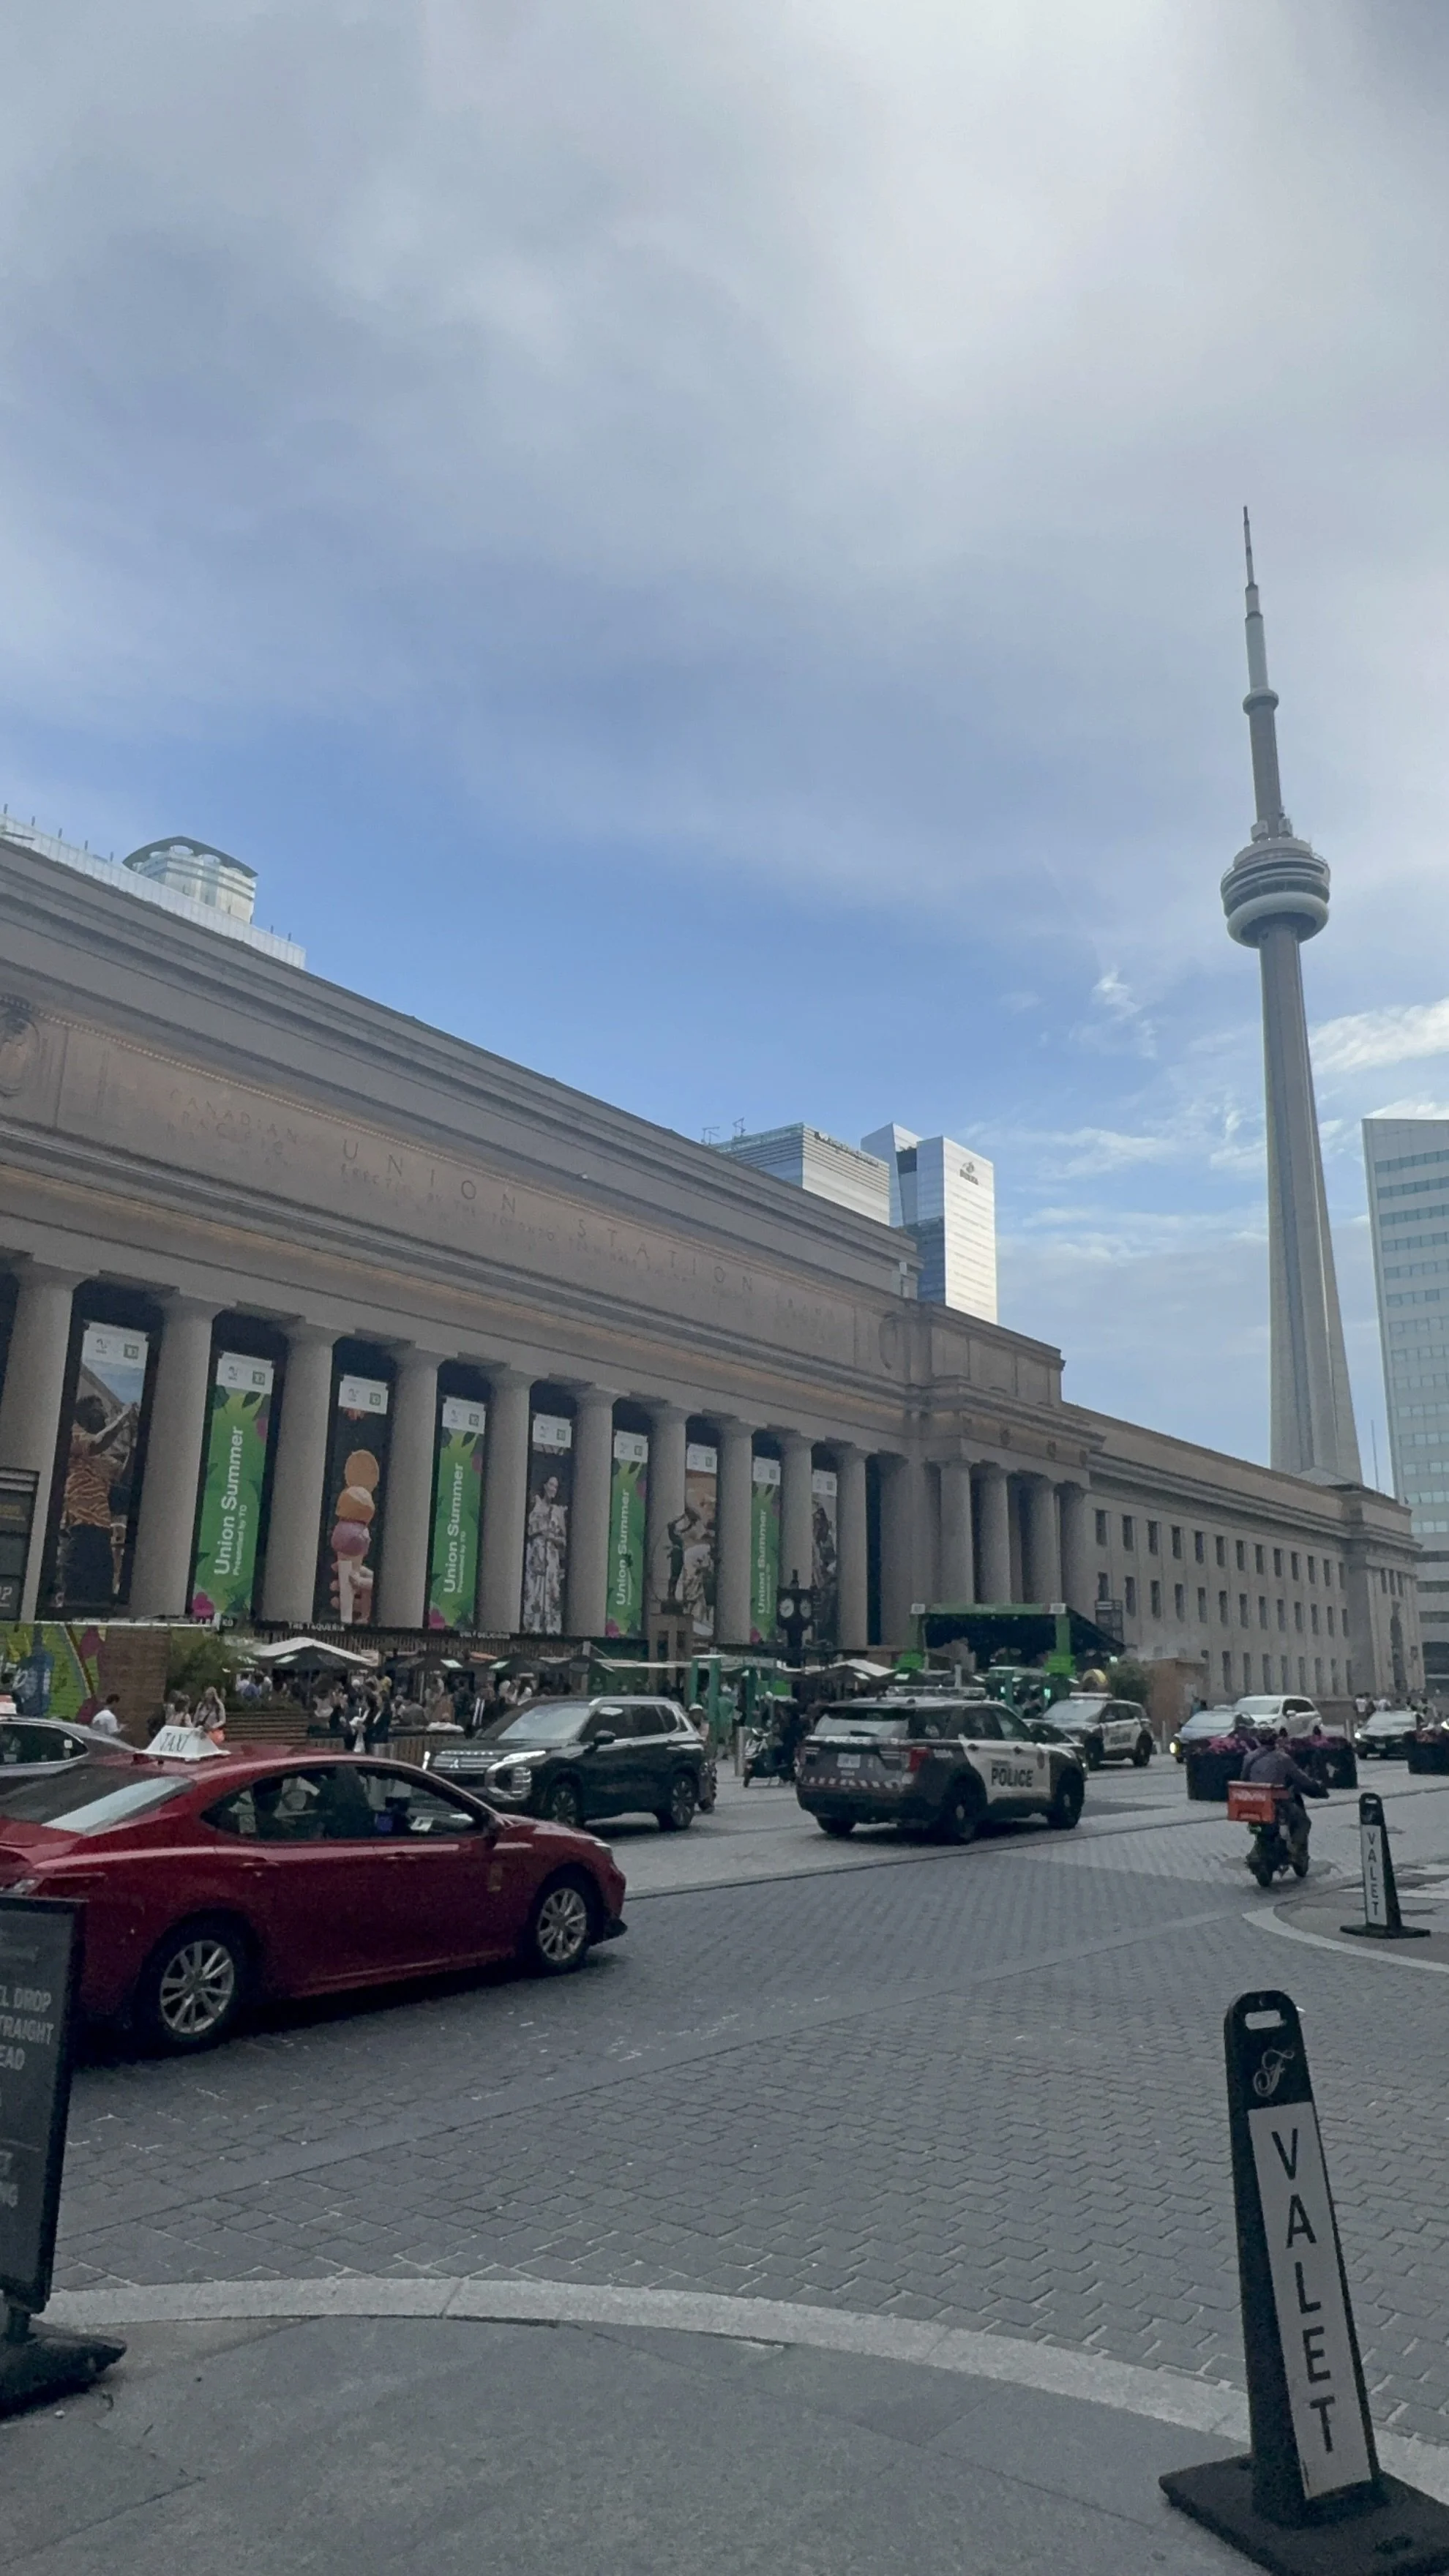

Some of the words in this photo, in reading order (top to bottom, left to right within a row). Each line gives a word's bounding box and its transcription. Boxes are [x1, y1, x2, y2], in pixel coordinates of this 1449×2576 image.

[342, 1137, 517, 1215] UNION
[575, 1218, 752, 1294] STATION
[221, 1426, 244, 1510] Summer
[239, 1505, 247, 1516] TD
[447, 1462, 463, 1537] Summer
[618, 1488, 629, 1555] Summer
[214, 1516, 235, 1575] Union
[443, 1541, 457, 1593] Union
[757, 1508, 767, 1568] Summer
[615, 1559, 627, 1606] Union
[757, 1572, 765, 1614] Union
[991, 1767, 1033, 1788] POLICE
[1366, 1832, 1379, 1916] VALET
[13, 1987, 52, 2012] DROP
[1272, 2127, 1336, 2454] VALET
